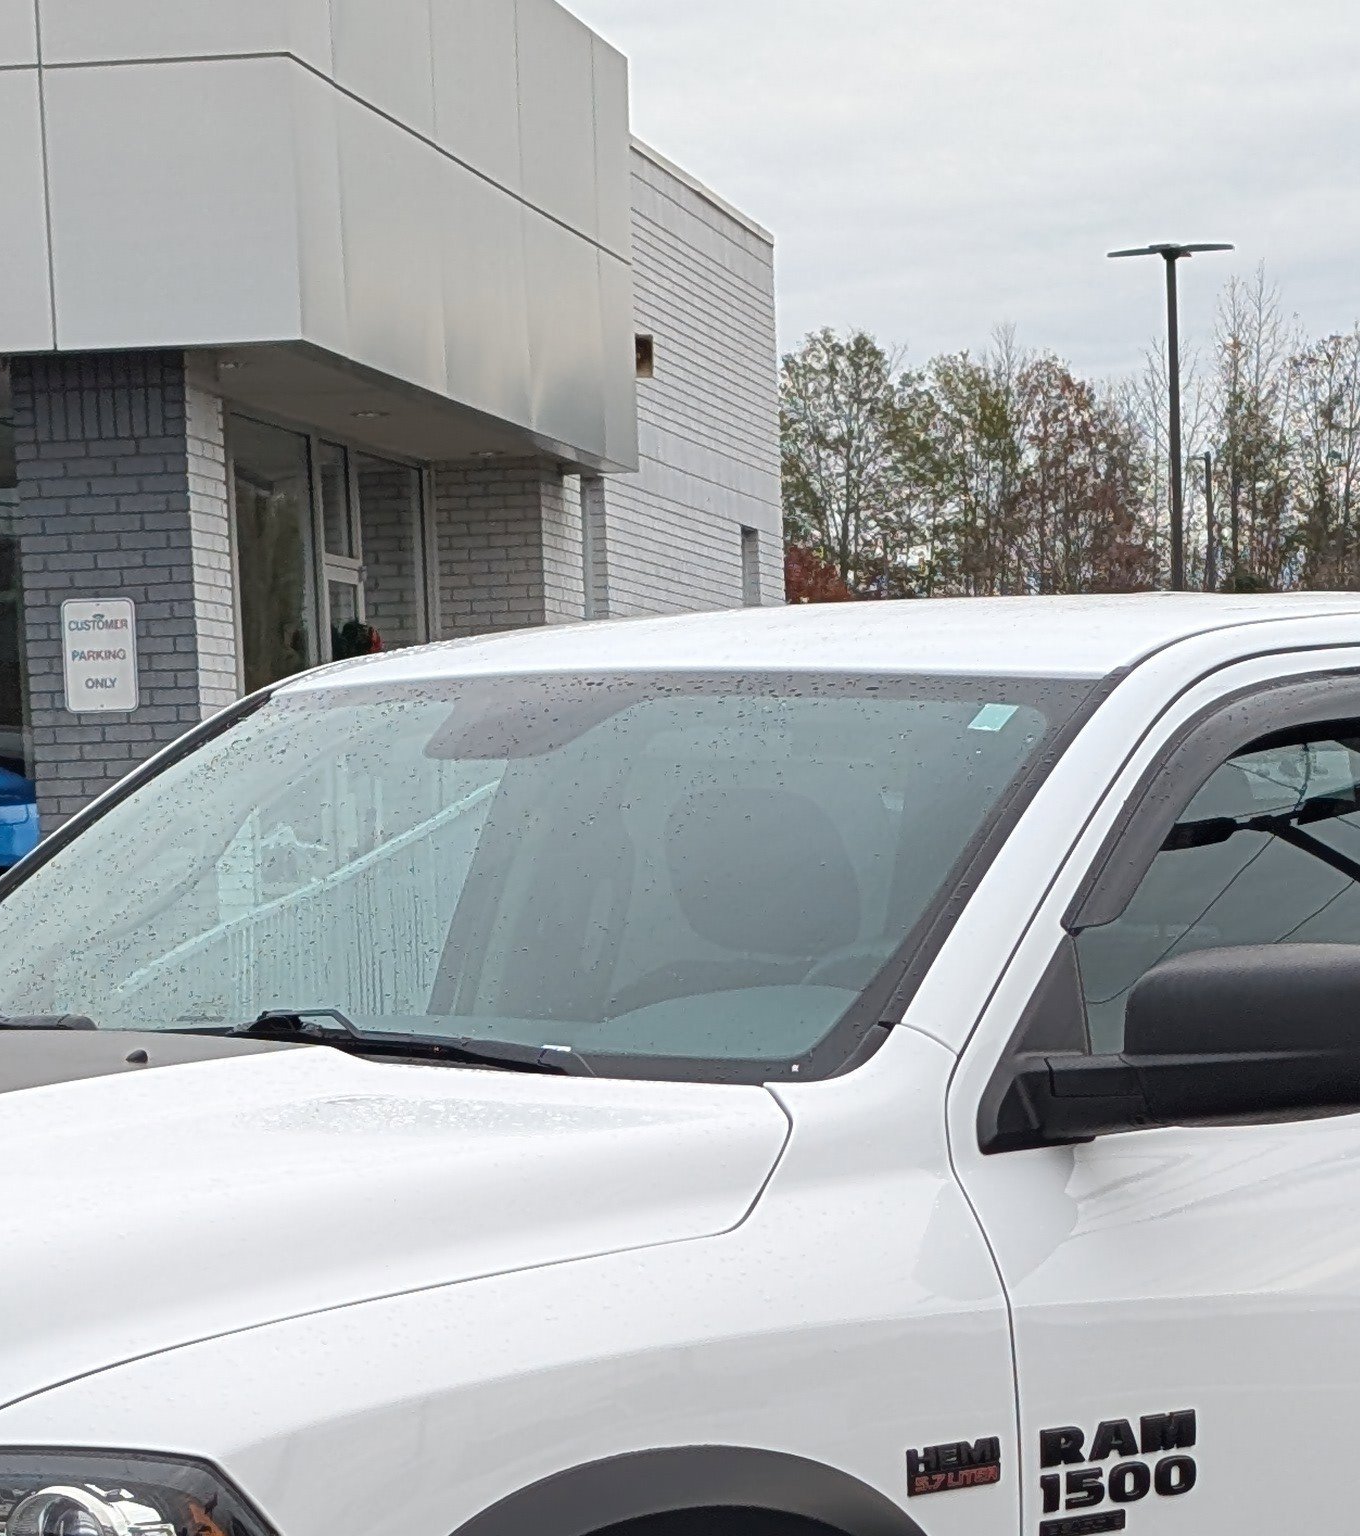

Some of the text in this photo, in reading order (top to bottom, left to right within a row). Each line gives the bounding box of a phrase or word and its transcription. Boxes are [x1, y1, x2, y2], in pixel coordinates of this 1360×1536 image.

[68, 618, 129, 631] CUSTOMER
[71, 648, 127, 661] PARKING
[85, 677, 118, 689] ONLY
[1040, 1408, 1197, 1469] RAM
[1040, 1455, 1197, 1513] 1500
